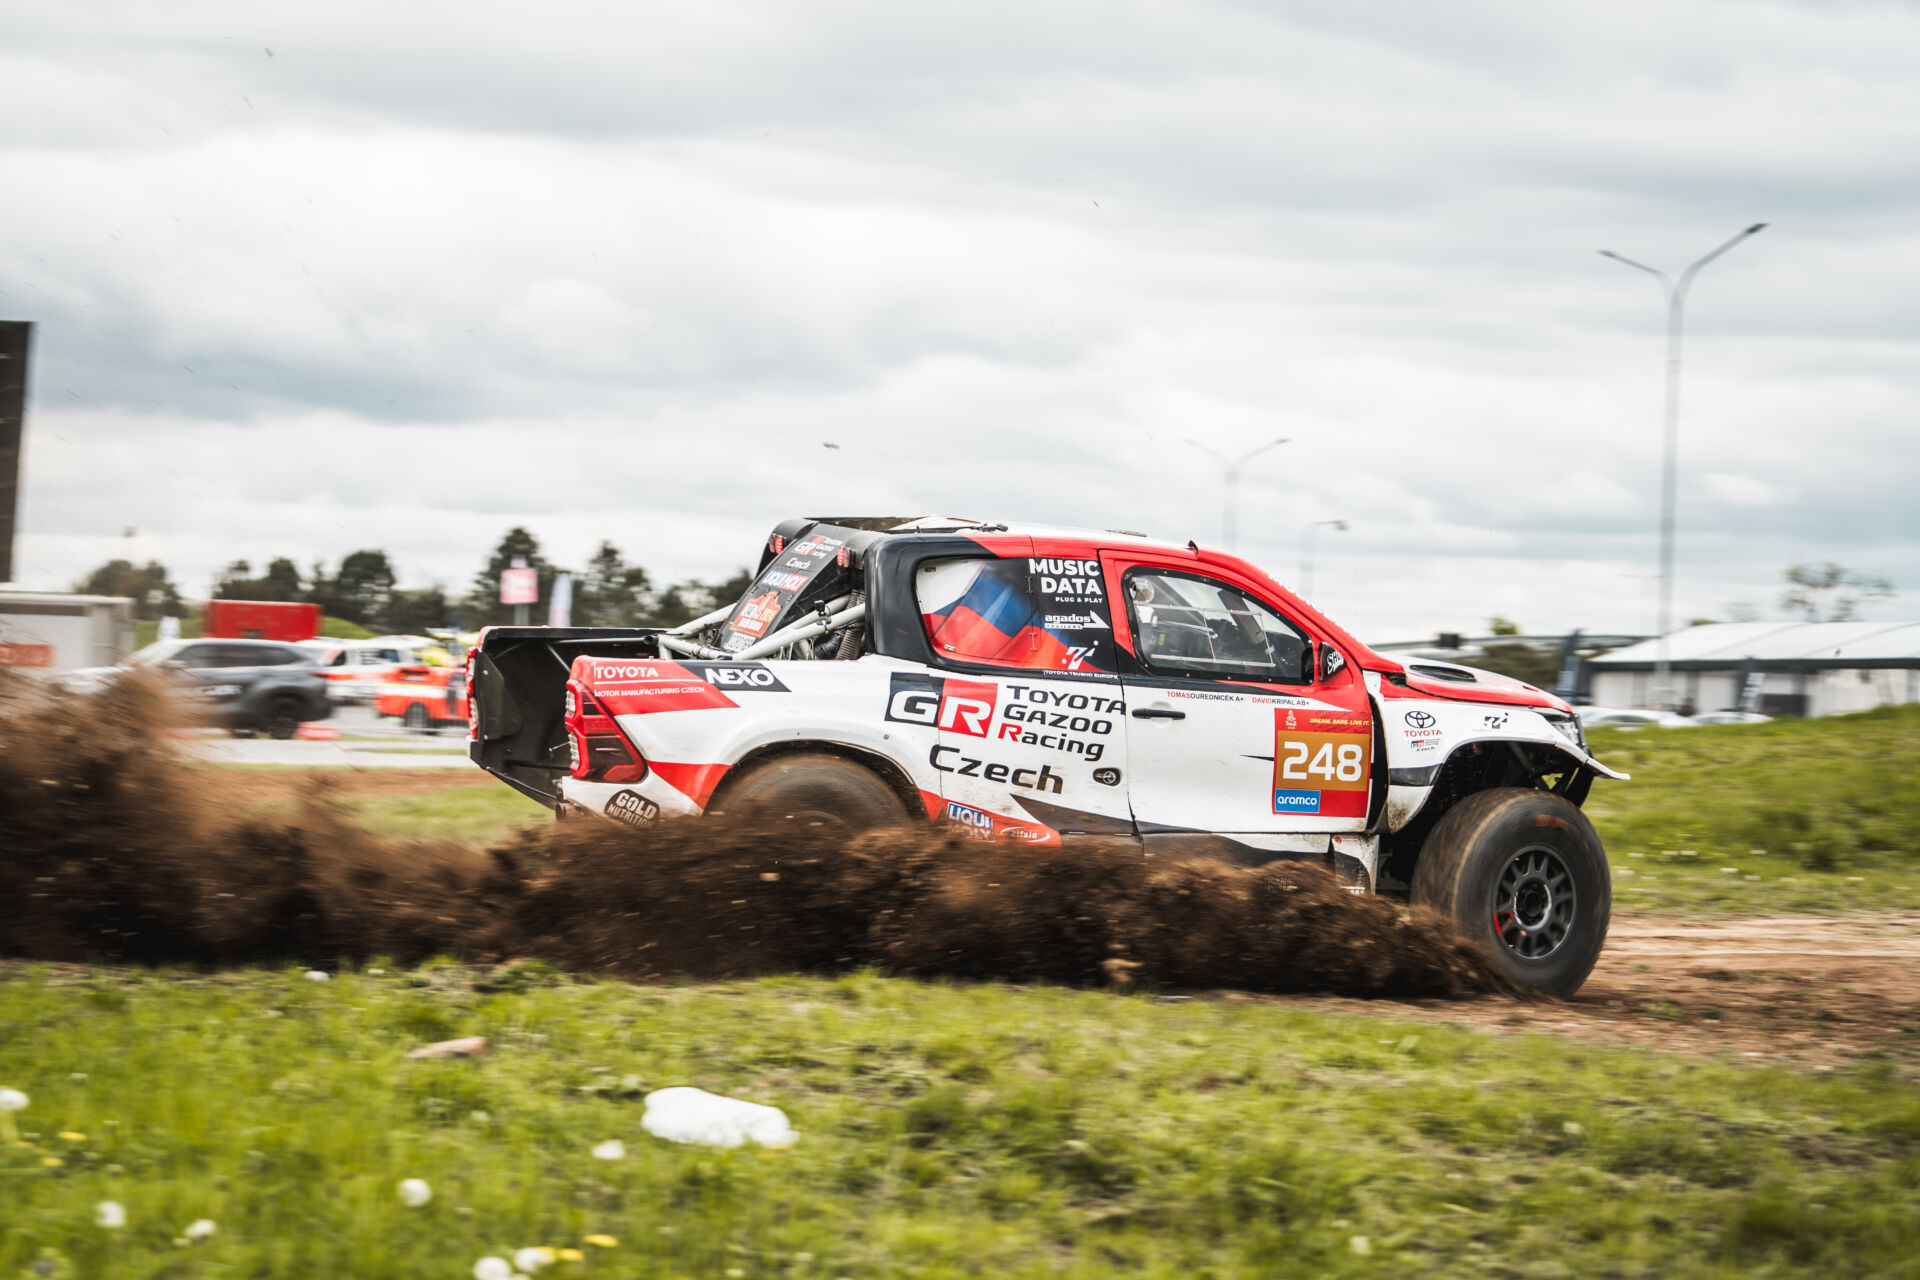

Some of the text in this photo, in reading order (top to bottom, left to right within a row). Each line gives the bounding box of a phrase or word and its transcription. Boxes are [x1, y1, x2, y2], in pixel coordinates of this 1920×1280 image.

[1028, 558, 1100, 577] MUSIC
[1040, 576, 1103, 595] DATA
[1045, 613, 1091, 624] agados
[595, 666, 659, 679] TOYOTA
[705, 668, 775, 687] NEXO
[595, 686, 705, 697] MOTOR MANUFACTURING CZECH
[1006, 684, 1126, 716] TOYOTA
[889, 689, 992, 735] GR
[1004, 703, 1113, 735] GAZOO
[998, 722, 1105, 761] Racing
[1404, 729, 1443, 737] TOYOTA
[929, 743, 1063, 794] Czech
[1283, 741, 1363, 782] 248
[615, 792, 657, 820] GOLD
[1277, 796, 1318, 806] aramco
[948, 804, 992, 829] LIQUI
